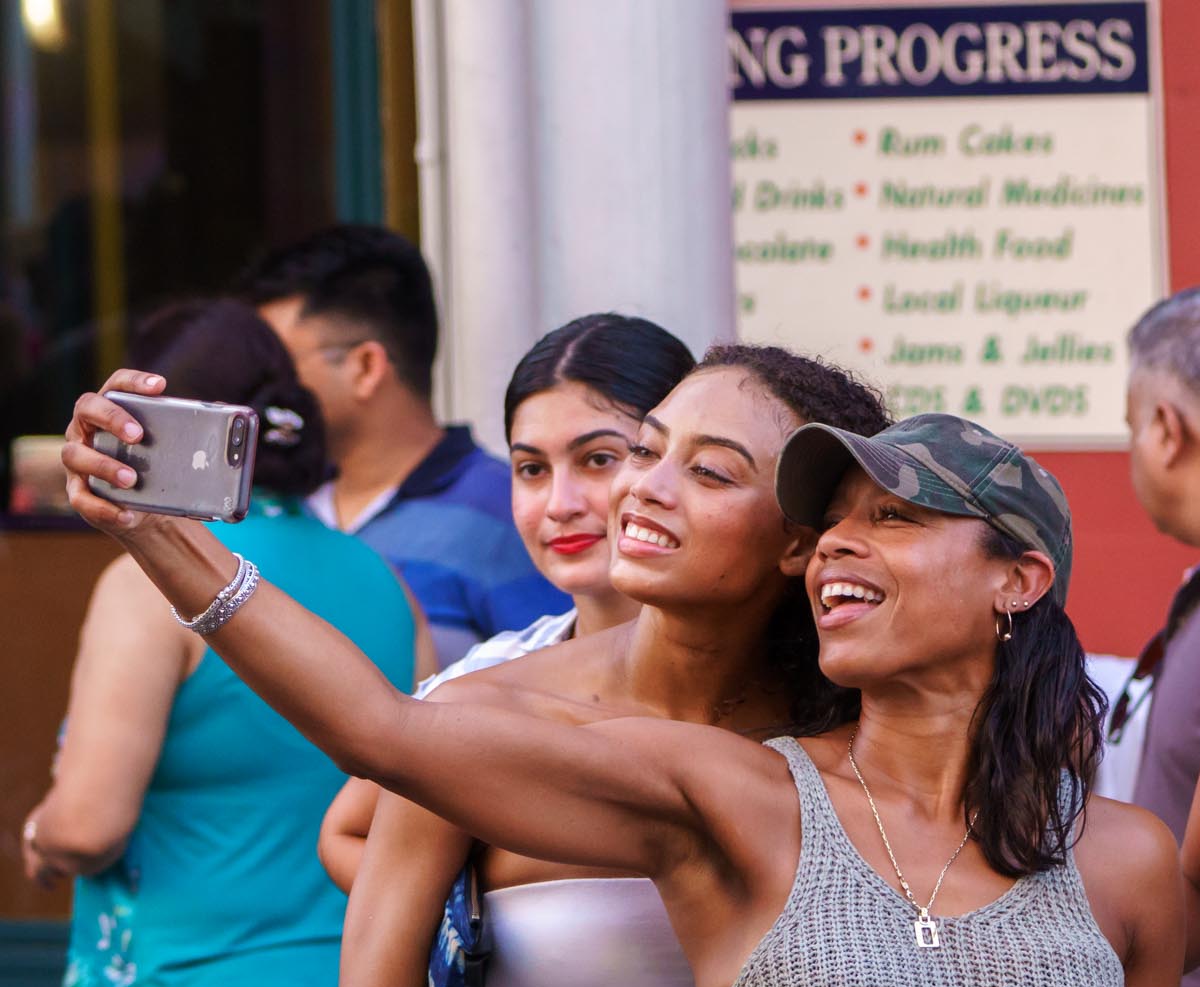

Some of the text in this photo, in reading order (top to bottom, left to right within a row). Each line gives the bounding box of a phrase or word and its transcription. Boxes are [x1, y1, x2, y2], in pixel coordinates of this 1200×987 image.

[822, 19, 1136, 86] PROGRESS
[879, 124, 1054, 156] Rum Cakes
[881, 174, 1144, 208] Natural Medicines
[882, 227, 1073, 259] Health Food
[883, 282, 963, 312] Local
[889, 335, 1113, 363] Jams & Jellies
[965, 387, 983, 414] &
